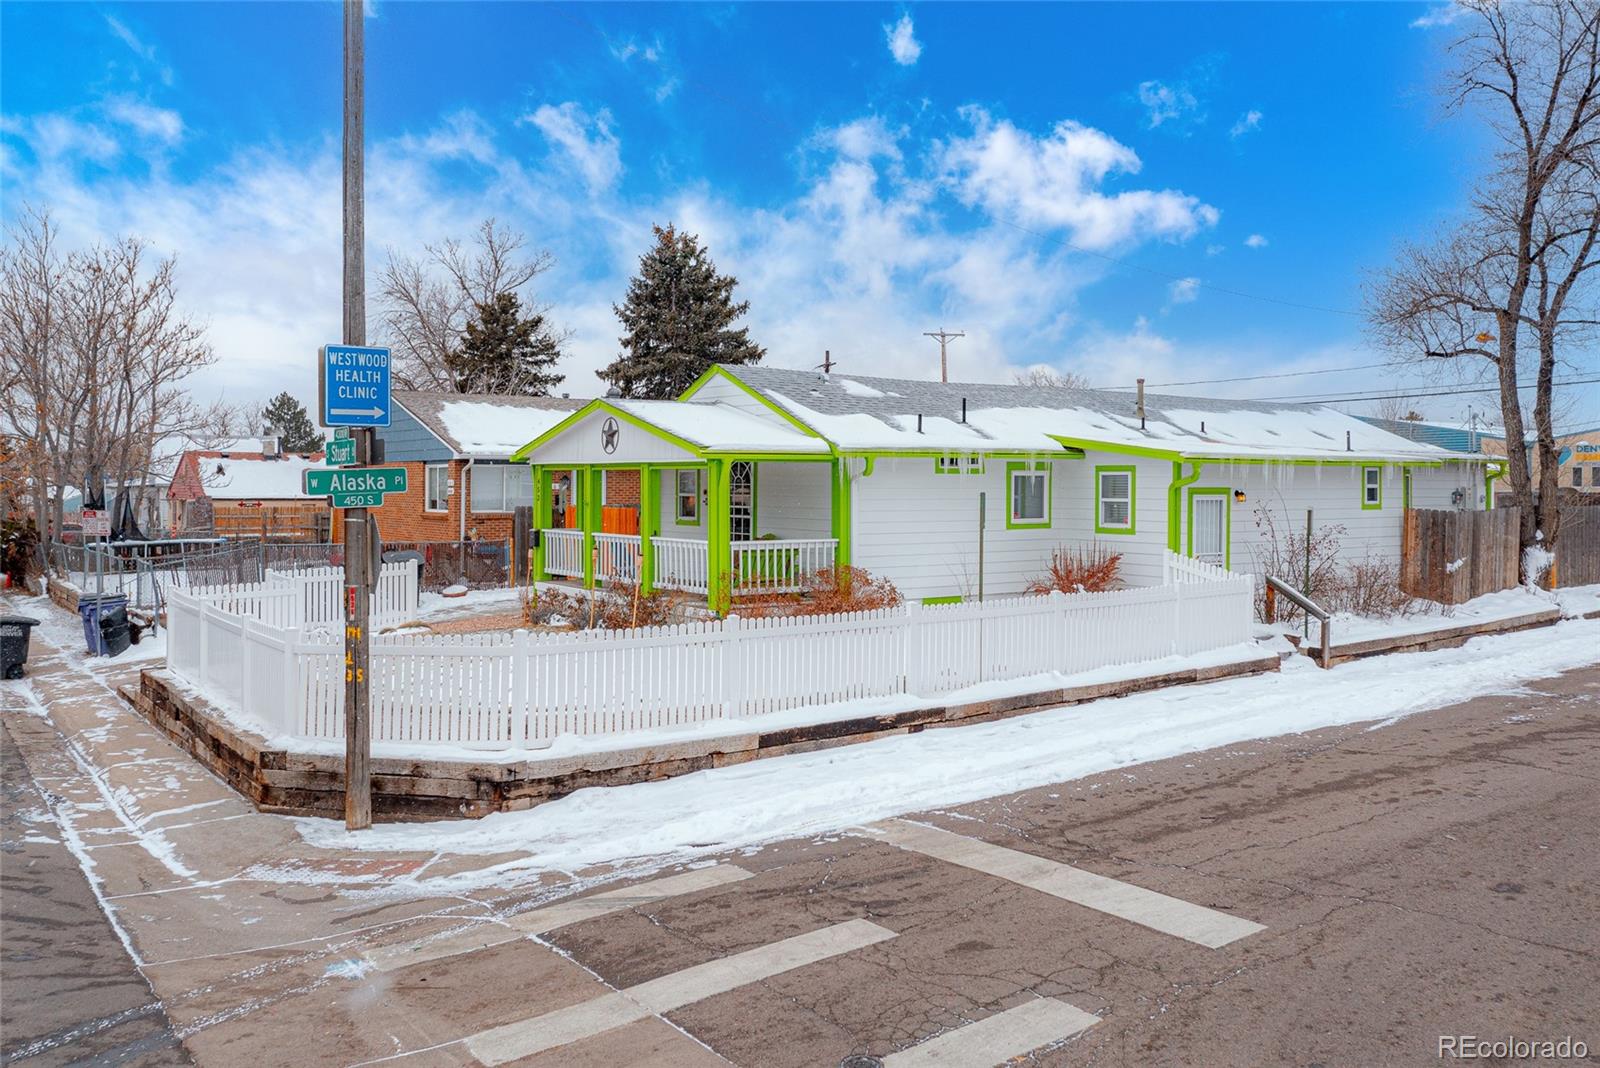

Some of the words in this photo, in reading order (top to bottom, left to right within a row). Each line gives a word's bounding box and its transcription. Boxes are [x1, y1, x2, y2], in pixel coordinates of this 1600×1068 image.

[329, 352, 387, 367] WESTWOOD
[335, 370, 381, 383] HEALTH
[339, 386, 377, 399] CLINIC
[331, 444, 350, 462] Stuart
[310, 479, 318, 488] W
[330, 474, 386, 491] Alaska
[394, 475, 403, 485] Pl
[344, 496, 363, 505] 450
[367, 495, 374, 505] S
